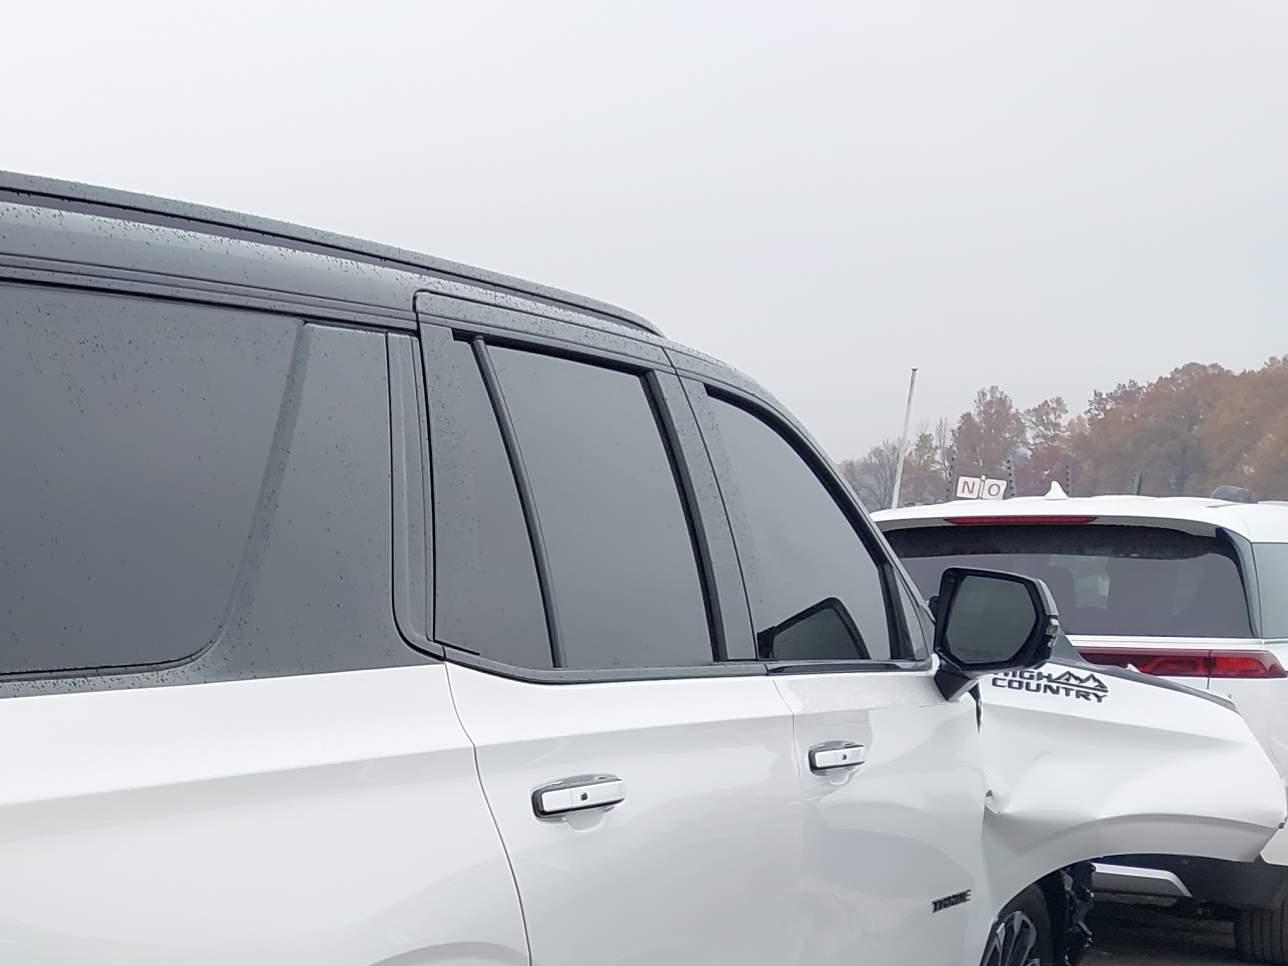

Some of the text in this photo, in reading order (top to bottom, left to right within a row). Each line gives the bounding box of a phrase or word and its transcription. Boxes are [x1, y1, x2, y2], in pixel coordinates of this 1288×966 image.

[962, 480, 1001, 497] N O
[992, 677, 1107, 703] COUNTRY
